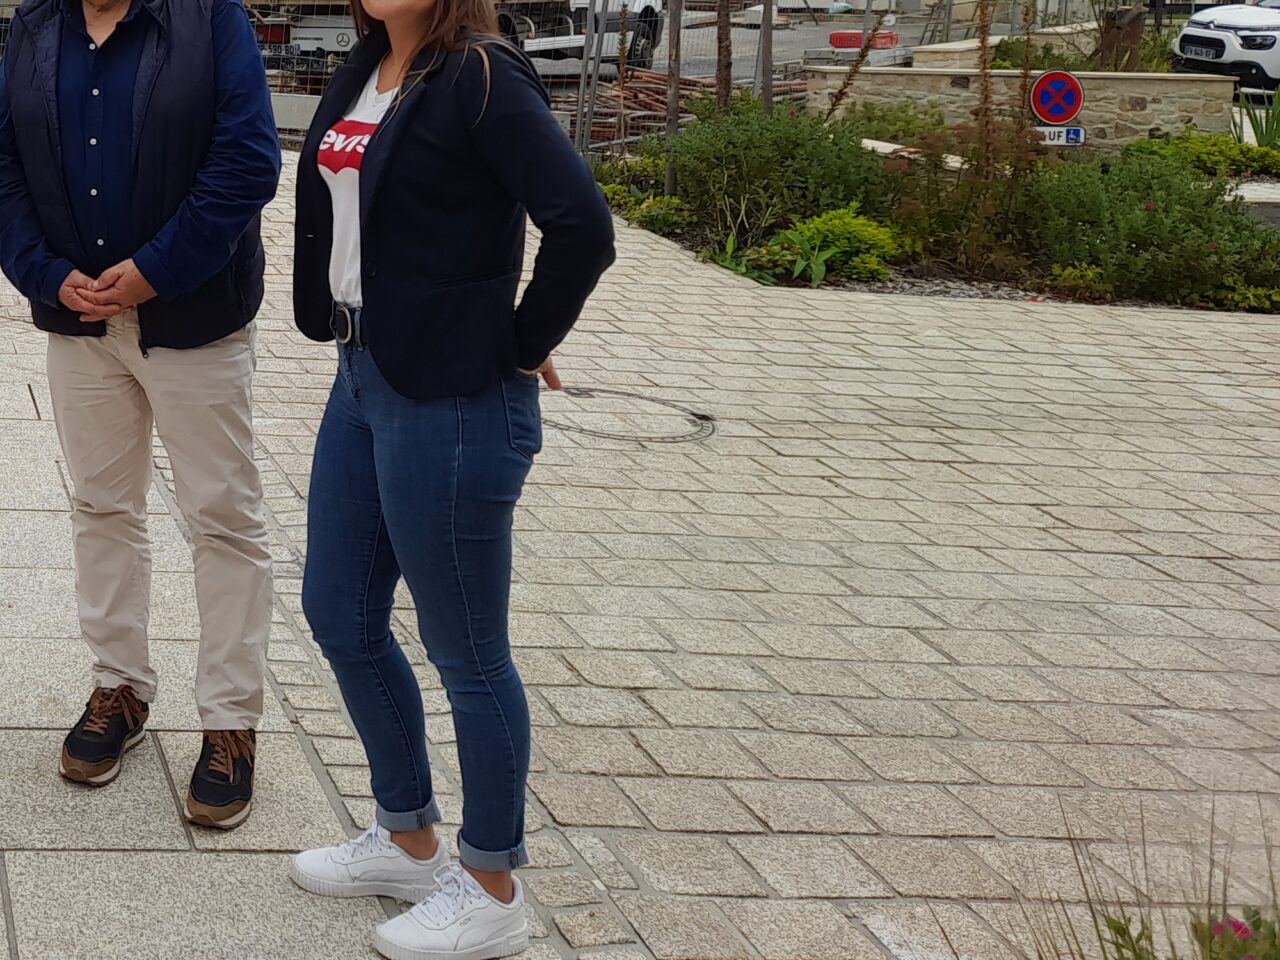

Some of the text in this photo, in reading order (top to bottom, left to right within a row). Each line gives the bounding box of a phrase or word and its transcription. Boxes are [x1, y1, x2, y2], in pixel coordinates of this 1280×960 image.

[258, 44, 295, 55] P-590-BD
[319, 129, 372, 154] evis
[1049, 131, 1063, 141] UF
